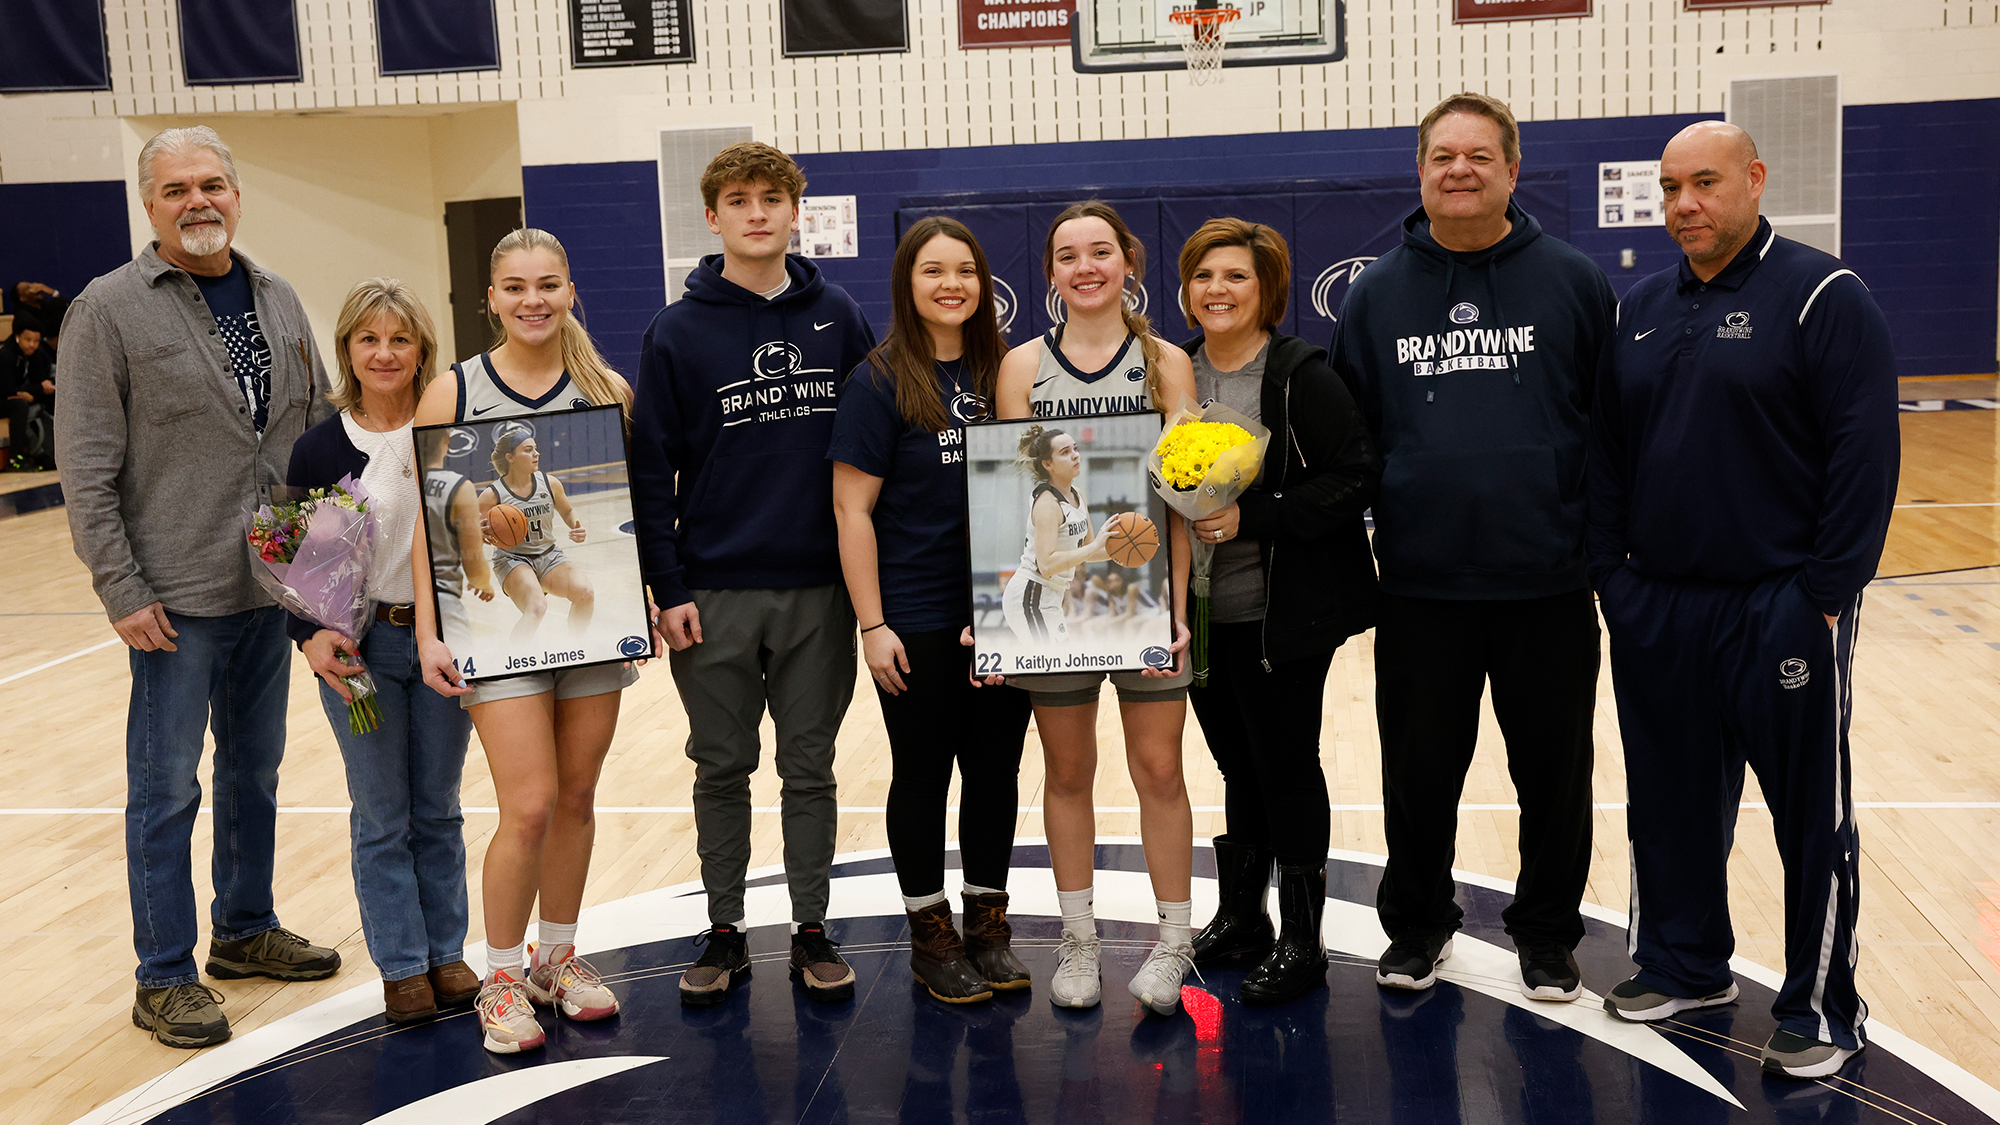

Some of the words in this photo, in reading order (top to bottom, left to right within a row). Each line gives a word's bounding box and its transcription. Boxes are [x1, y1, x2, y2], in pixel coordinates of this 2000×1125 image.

[977, 9, 1068, 31] CHAMPIONS
[1396, 326, 1535, 364] BRANDYWINE
[1415, 356, 1507, 375] BASKETBAL
[754, 406, 811, 423] THLETCS
[505, 655, 537, 670] Jess
[541, 648, 585, 665] James
[977, 652, 1002, 673] 22
[1015, 654, 1061, 673] Kaitlyn
[1065, 653, 1123, 668] Johnson
